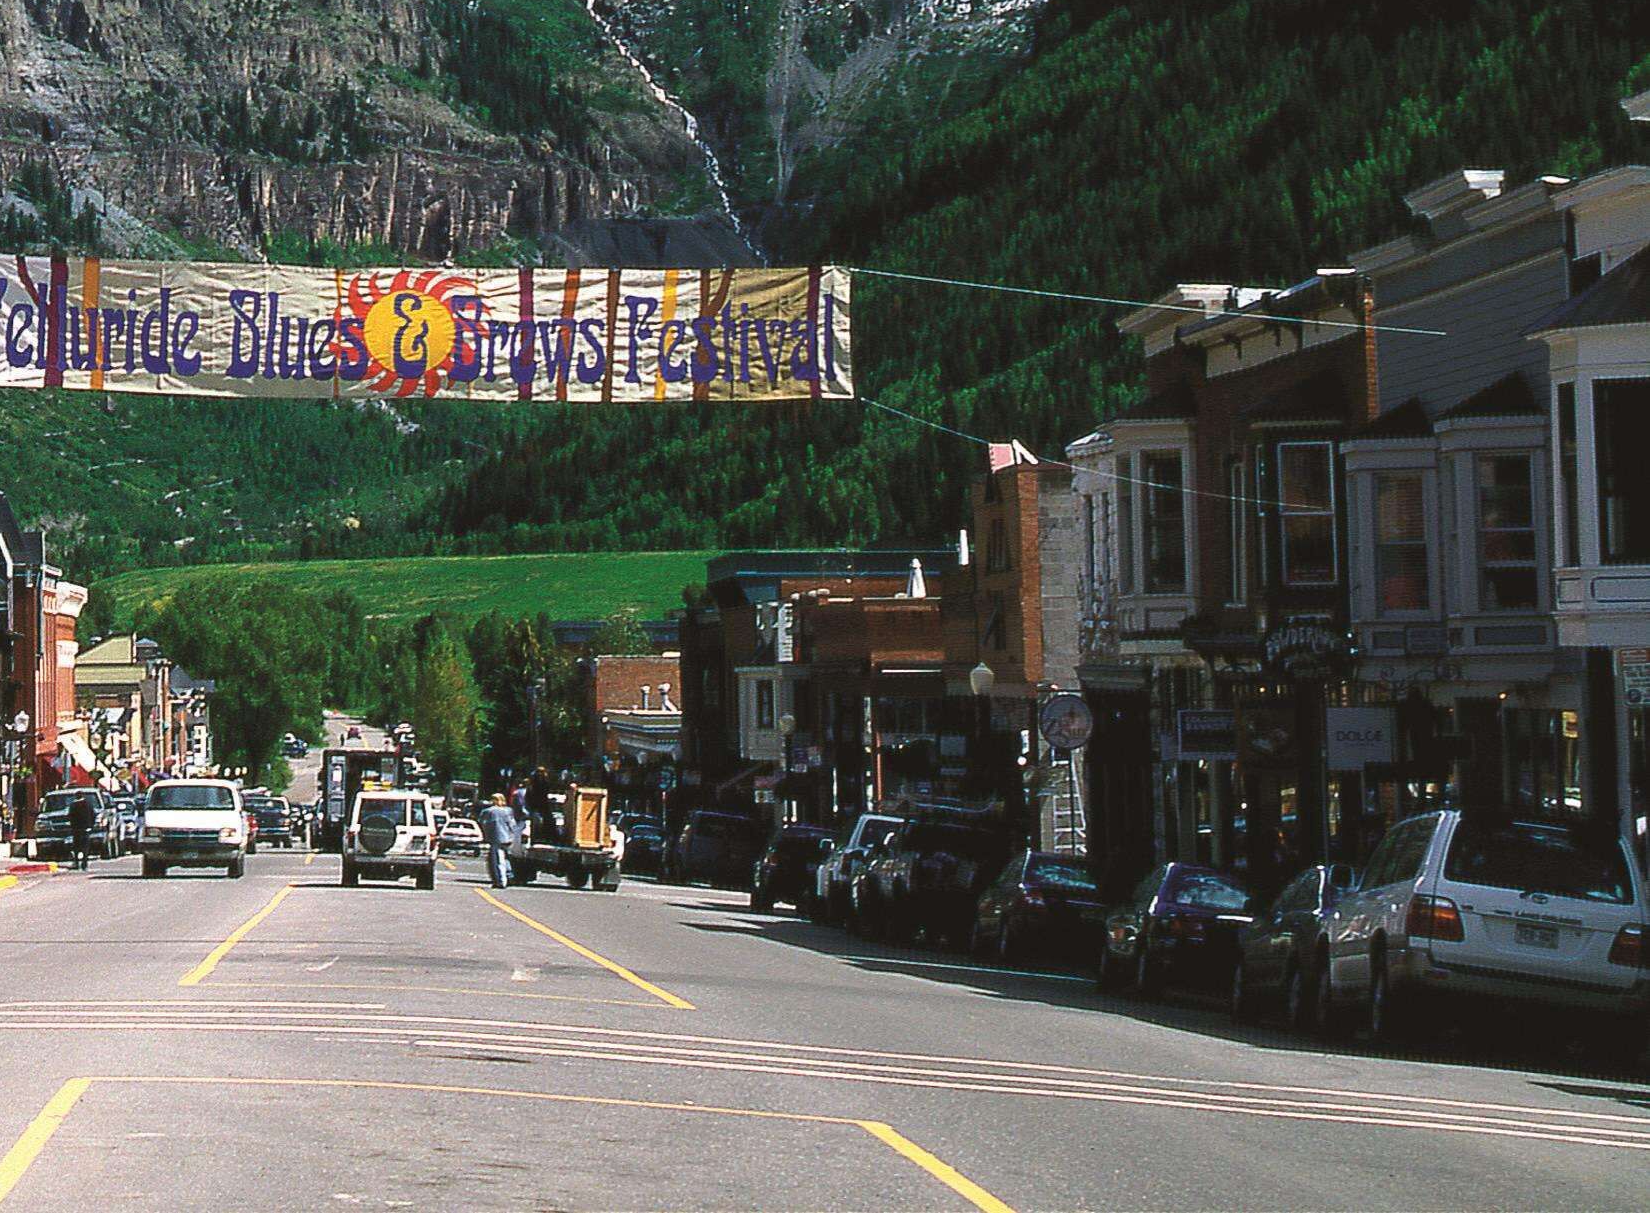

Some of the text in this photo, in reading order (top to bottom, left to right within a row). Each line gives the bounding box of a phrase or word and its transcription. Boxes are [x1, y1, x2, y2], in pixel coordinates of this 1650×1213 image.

[226, 289, 370, 381] Blues
[392, 292, 429, 380] &
[623, 293, 837, 386] Festival
